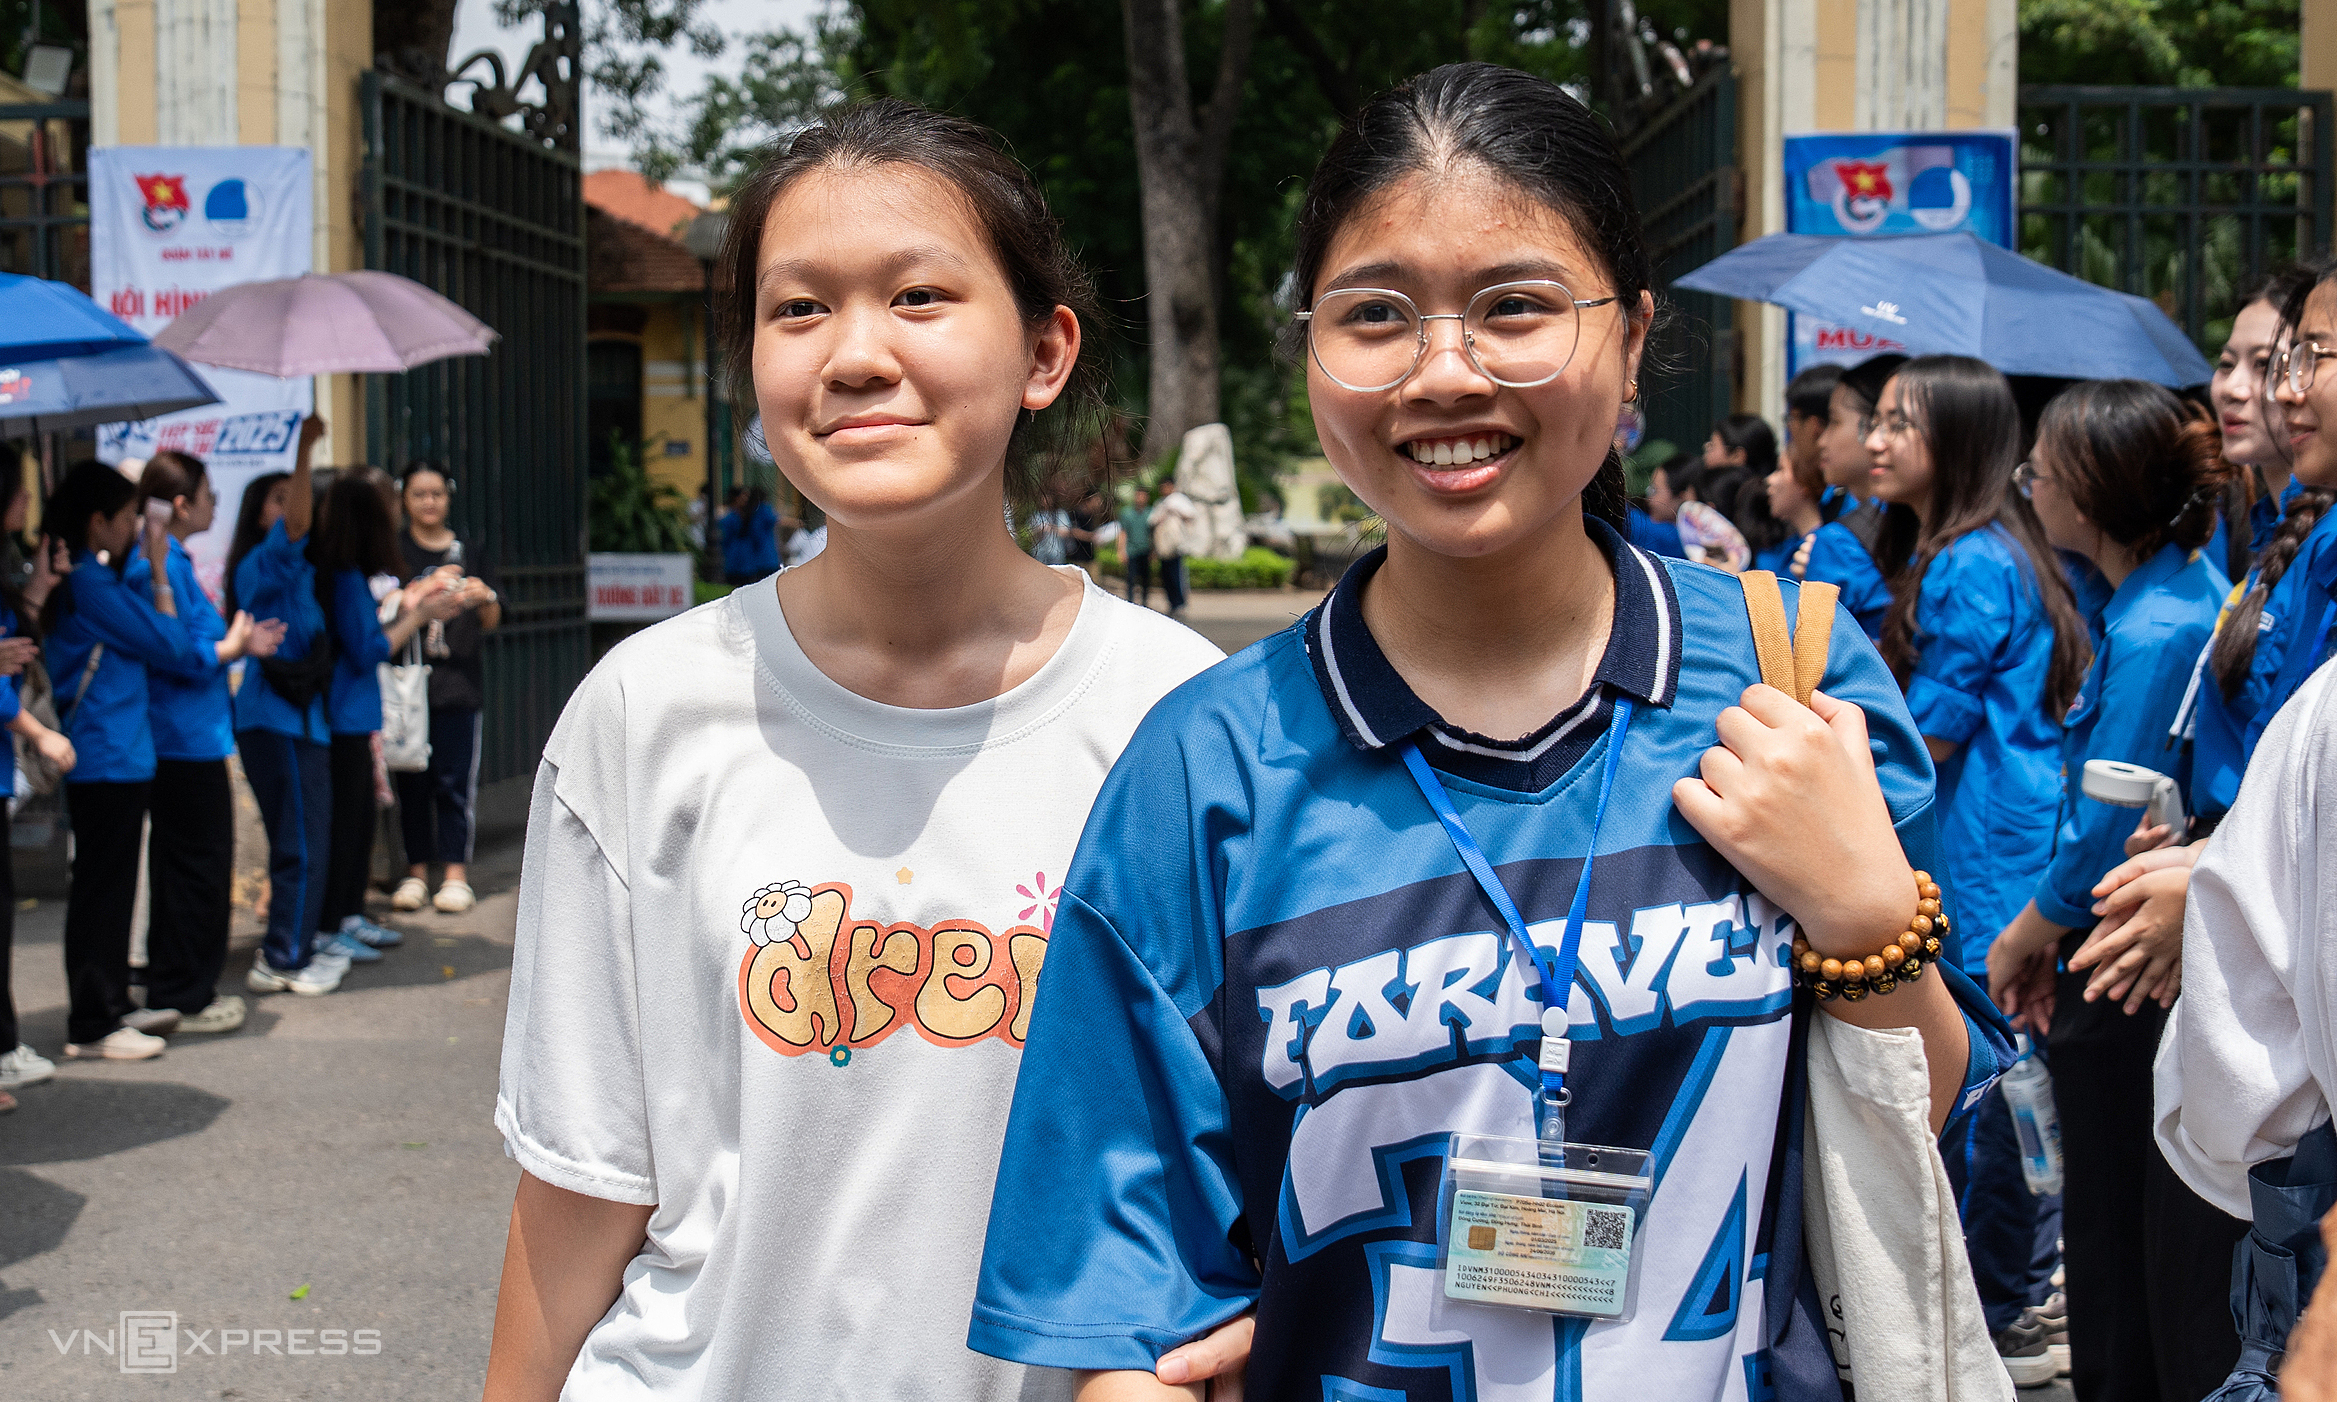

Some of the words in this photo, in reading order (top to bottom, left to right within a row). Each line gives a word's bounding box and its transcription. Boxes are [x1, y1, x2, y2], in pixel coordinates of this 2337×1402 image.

[218, 413, 295, 453] 2025
[1457, 1272, 1615, 1296] 1006249F3506248VNM<<<<<<<<<<<8
[1458, 1264, 1616, 1287] IDVNM3100005434034310000543<<7
